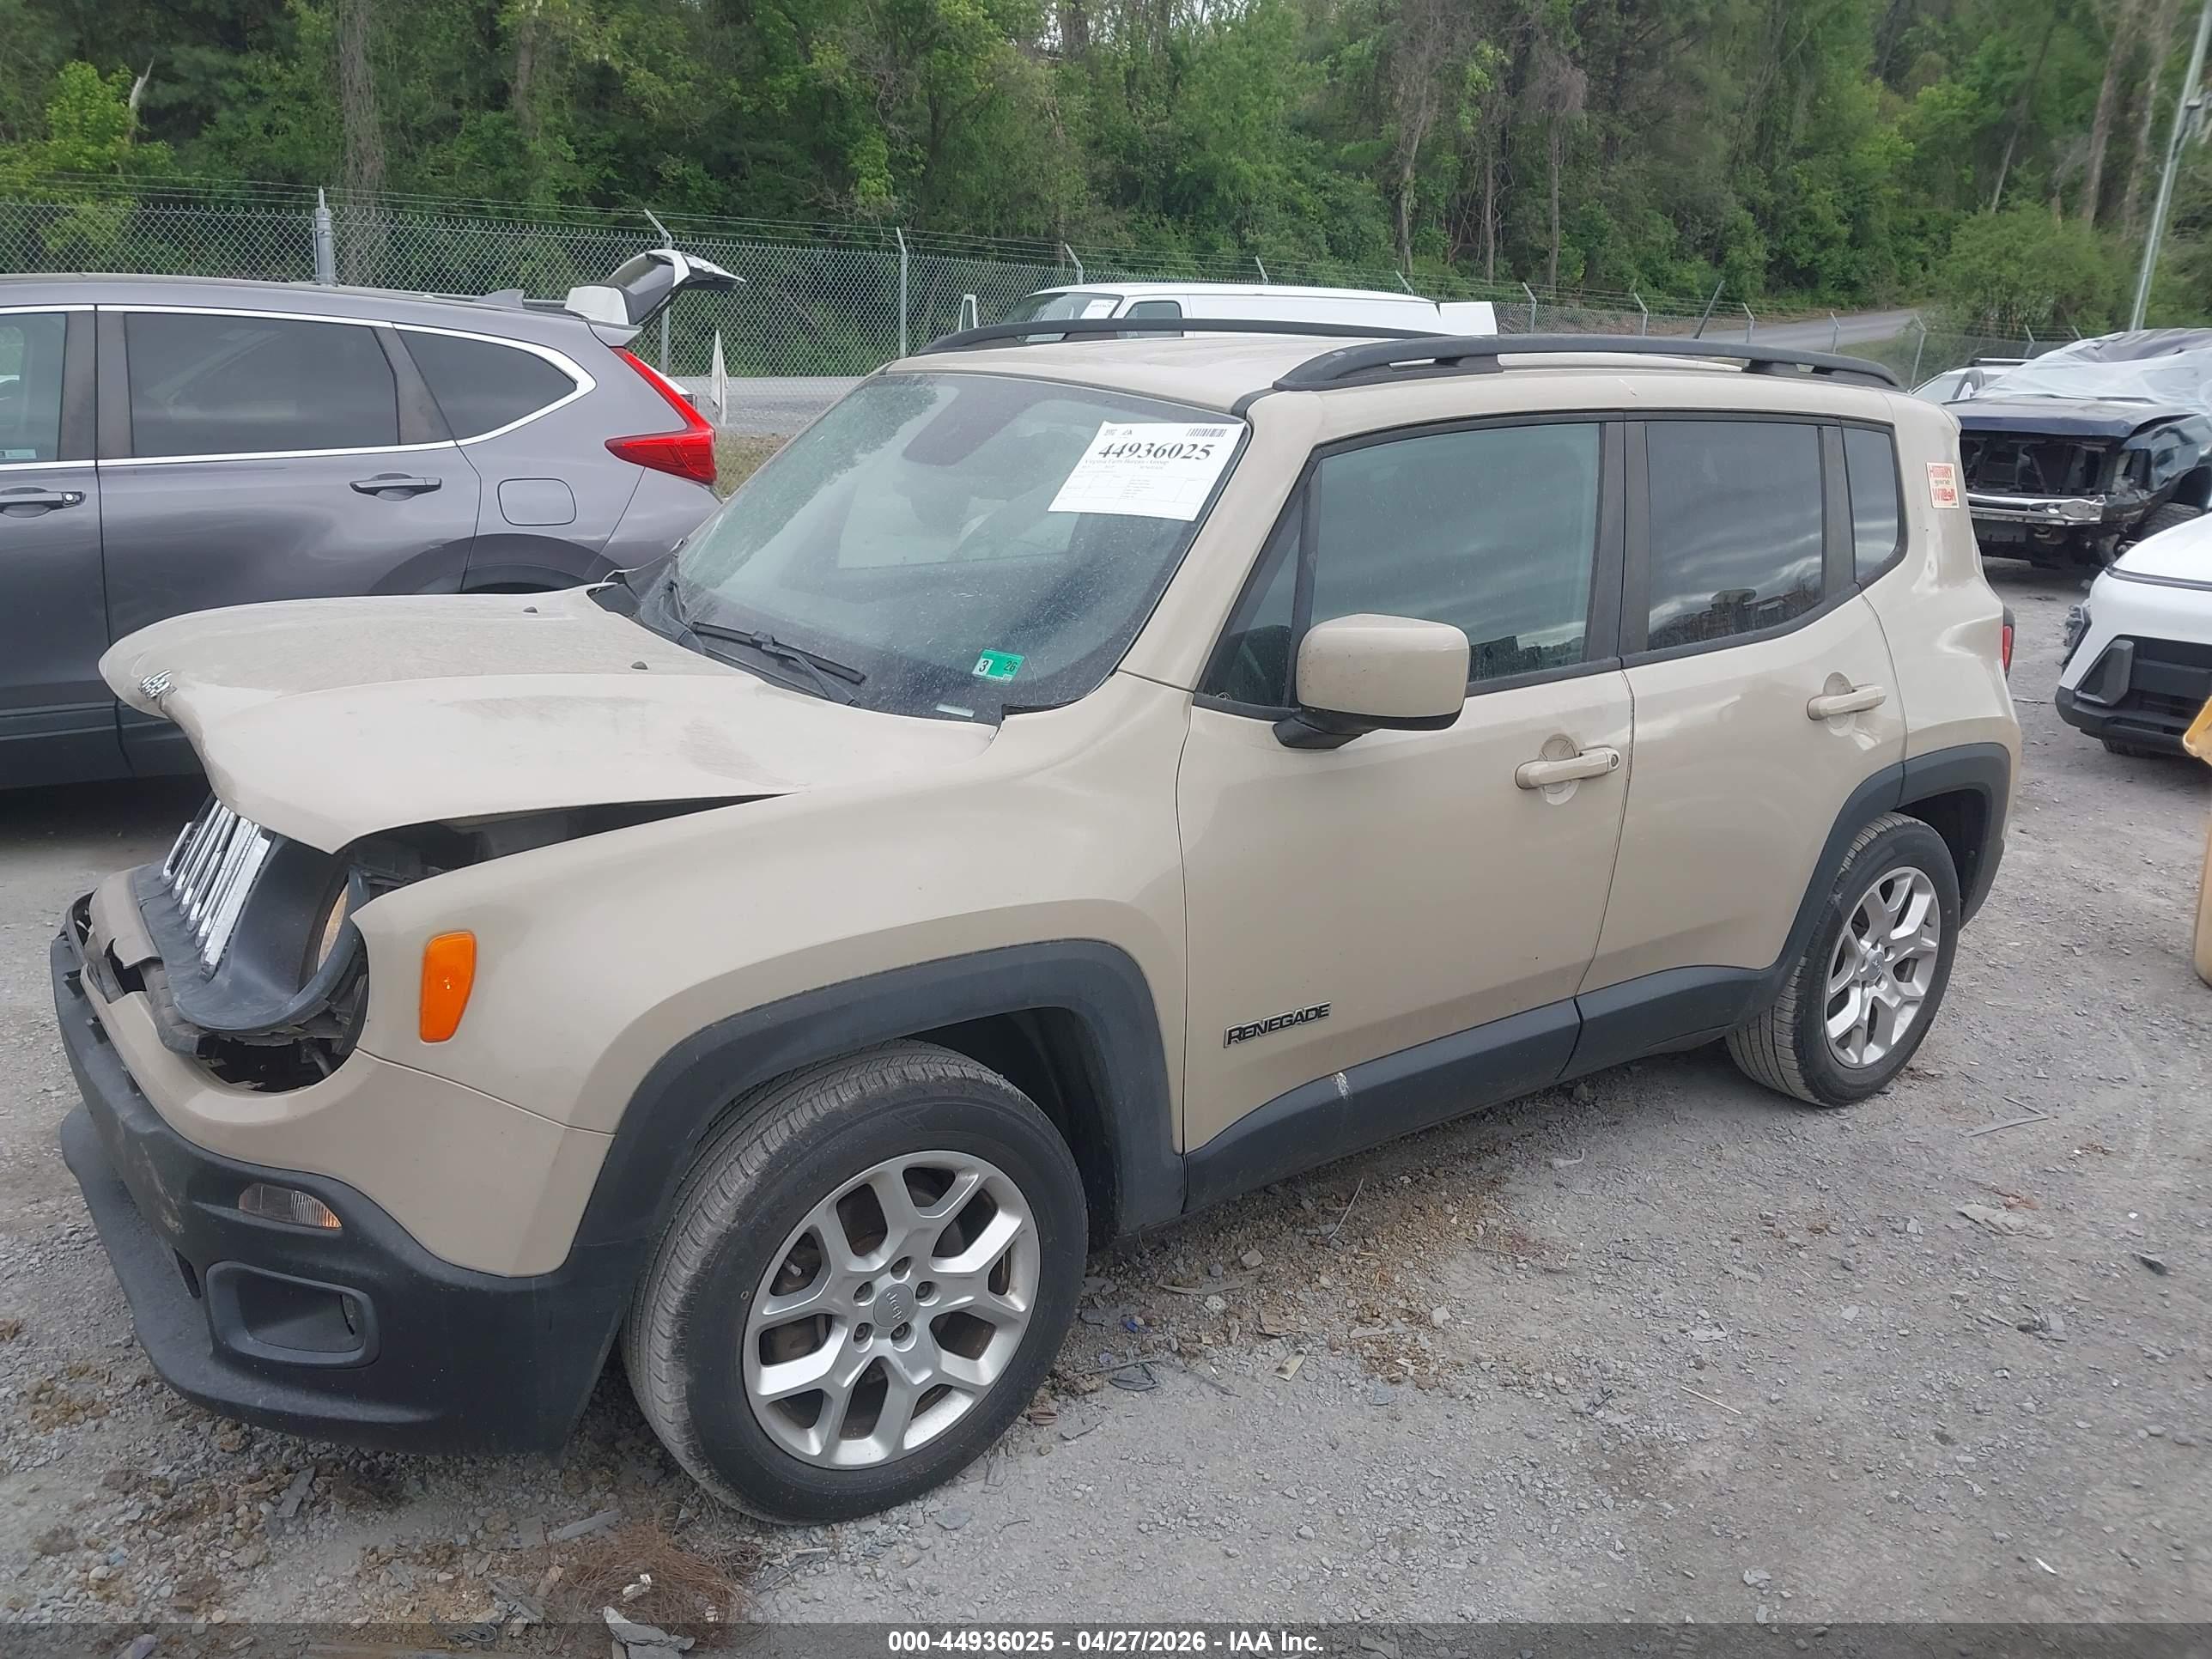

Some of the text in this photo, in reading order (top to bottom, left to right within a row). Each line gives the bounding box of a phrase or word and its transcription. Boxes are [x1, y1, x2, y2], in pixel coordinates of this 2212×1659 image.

[1097, 442, 1216, 461] 44936025
[979, 659, 989, 672] 3
[1003, 660, 1018, 672] 26
[1224, 1001, 1331, 1048] RENEGADE
